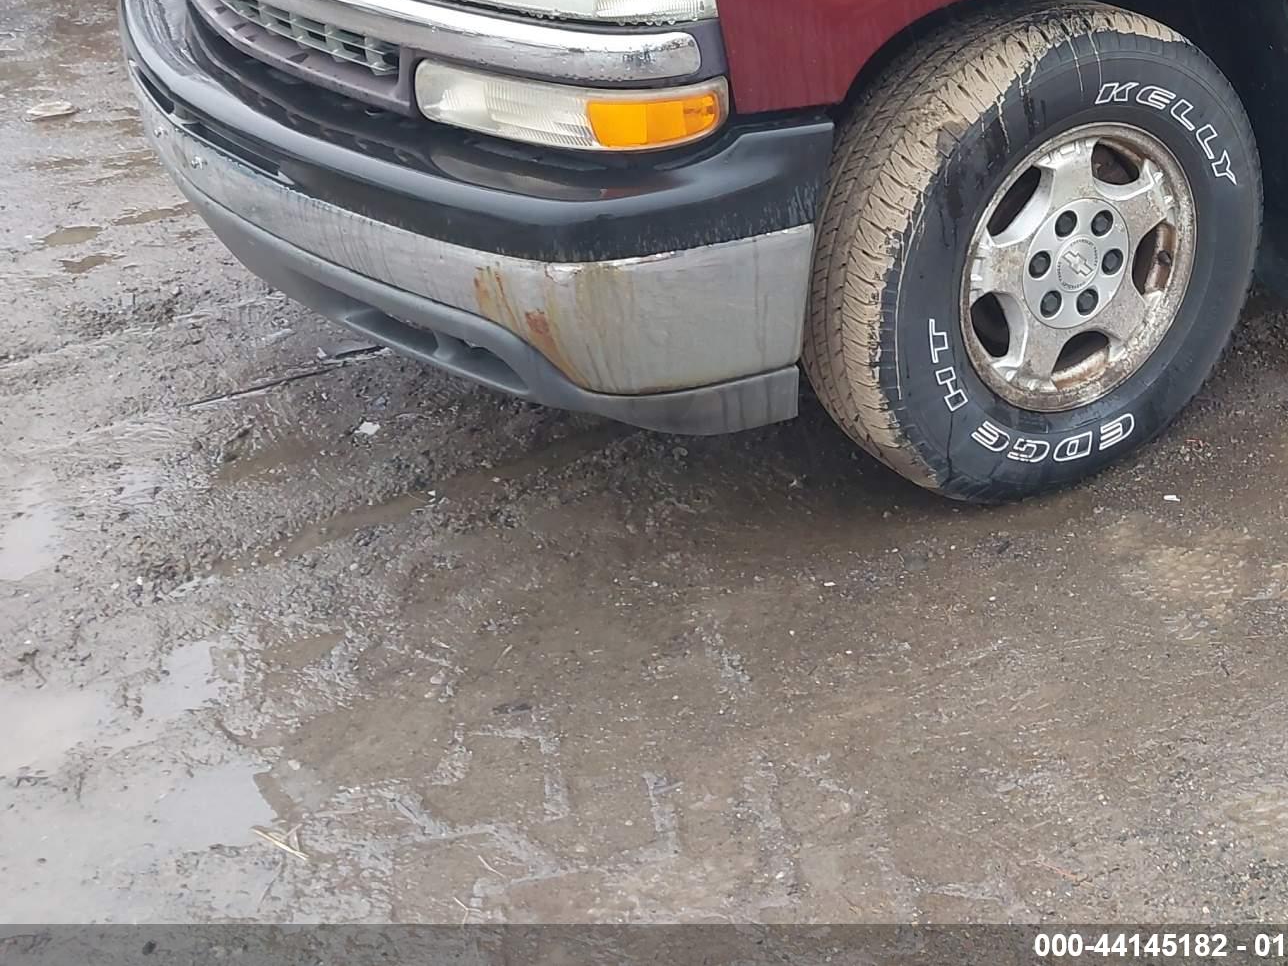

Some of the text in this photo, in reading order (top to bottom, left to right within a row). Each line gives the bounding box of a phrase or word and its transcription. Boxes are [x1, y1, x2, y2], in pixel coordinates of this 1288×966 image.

[1095, 82, 1238, 185] KELLY
[928, 318, 1135, 463] EDGE HT
